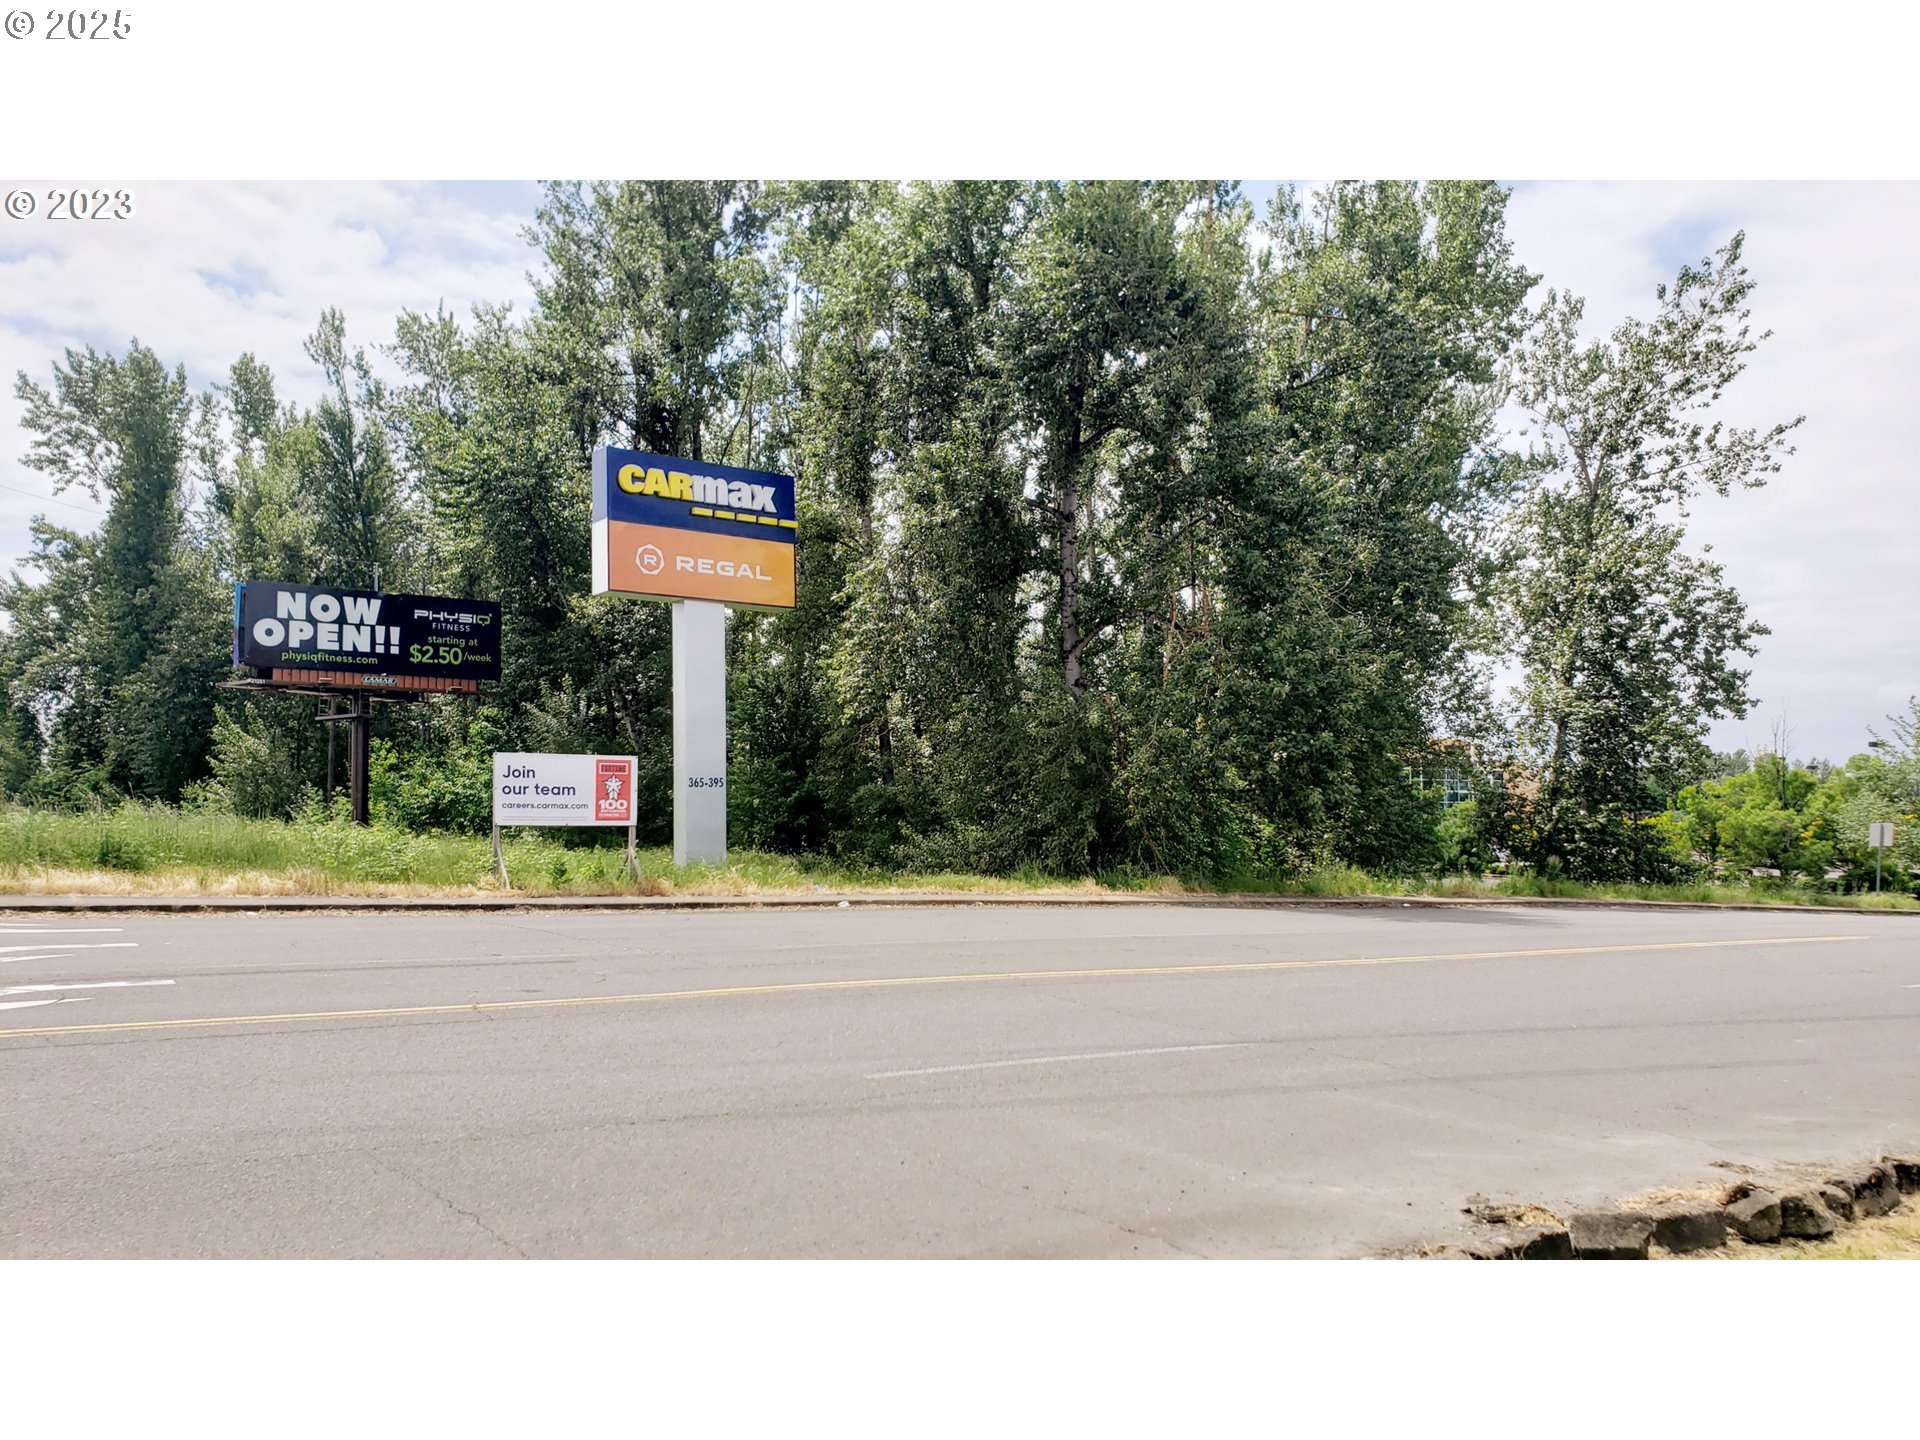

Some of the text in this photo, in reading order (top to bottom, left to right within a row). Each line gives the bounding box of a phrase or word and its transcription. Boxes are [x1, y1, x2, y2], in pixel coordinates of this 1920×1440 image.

[676, 556, 772, 581] REGAL
[276, 590, 382, 626] NOW
[432, 622, 471, 632] FITNESS
[252, 617, 401, 655] OPEN!!
[427, 635, 479, 648] starting at
[281, 650, 379, 666] physiqfitness.com
[409, 643, 463, 665] $2.50
[502, 764, 536, 779] Join
[688, 776, 724, 788] 365-395
[502, 783, 577, 796] our team
[501, 802, 589, 810] careers.carmax.com
[598, 799, 628, 810] 100
